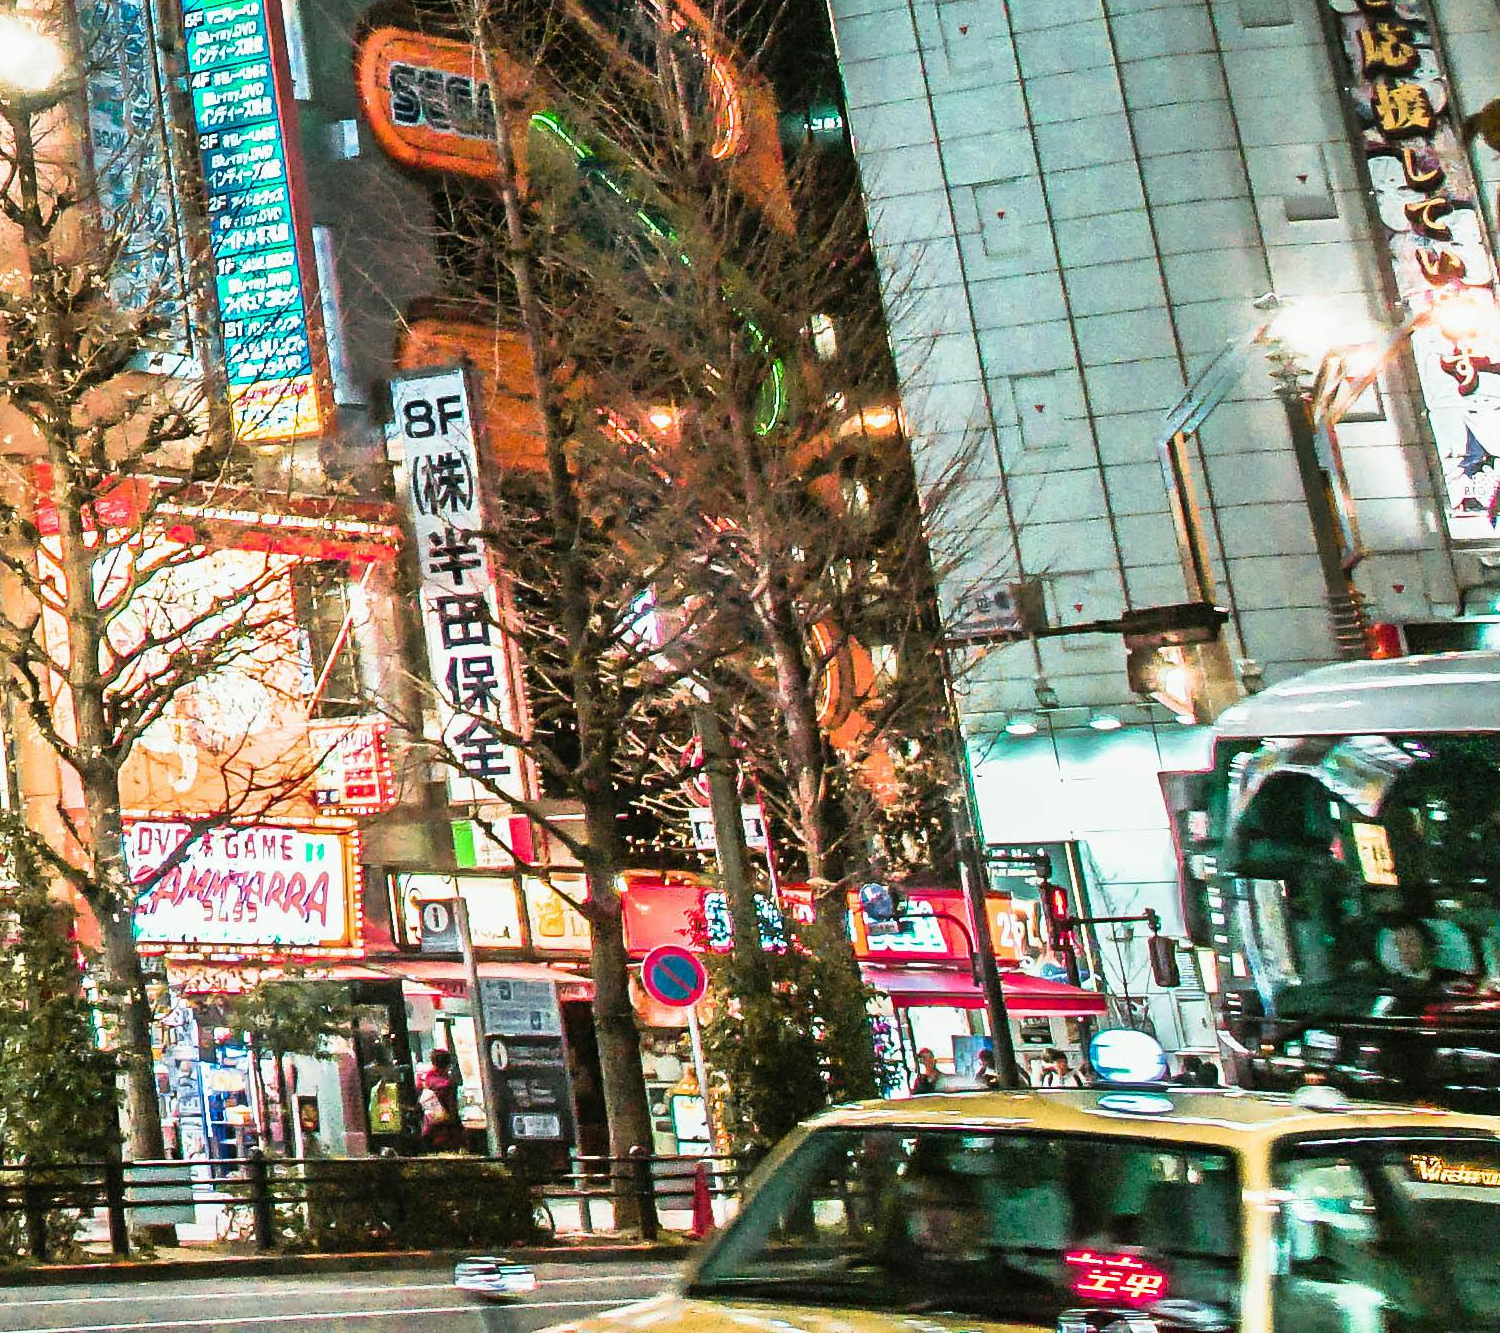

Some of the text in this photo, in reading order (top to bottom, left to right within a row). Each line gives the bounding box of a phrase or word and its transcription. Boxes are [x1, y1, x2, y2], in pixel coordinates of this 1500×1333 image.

[191, 70, 211, 89] 4F
[199, 134, 219, 151] 3F
[207, 194, 227, 213] 2F
[216, 259, 236, 278] 1F
[402, 394, 466, 440] 8F
[222, 830, 297, 863] GAME
